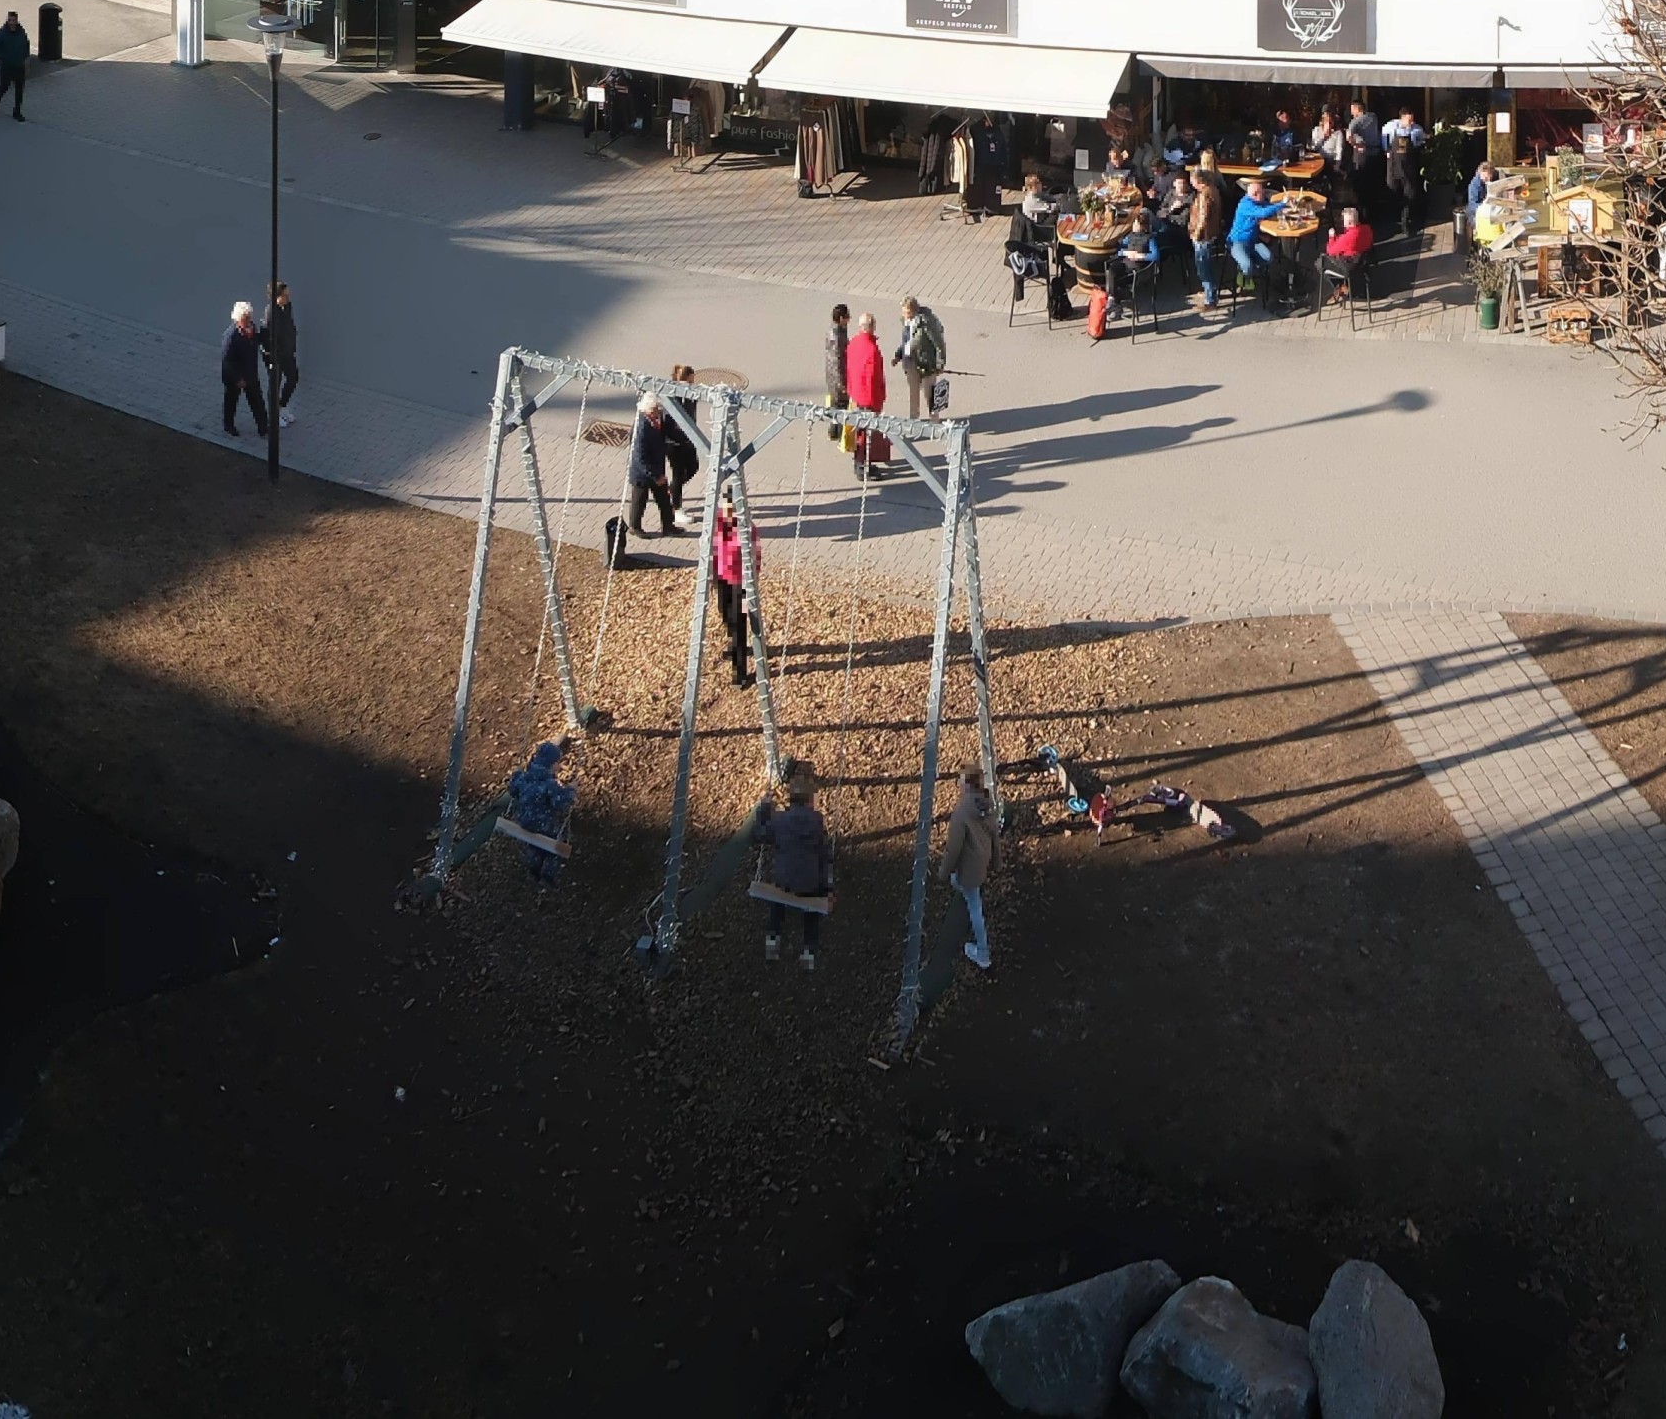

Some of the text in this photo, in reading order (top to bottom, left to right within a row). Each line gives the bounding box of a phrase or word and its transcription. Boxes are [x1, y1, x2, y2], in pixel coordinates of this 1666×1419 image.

[915, 19, 945, 27] SEEFELD
[947, 21, 982, 29] SHOPPING
[760, 127, 799, 141] fashio
